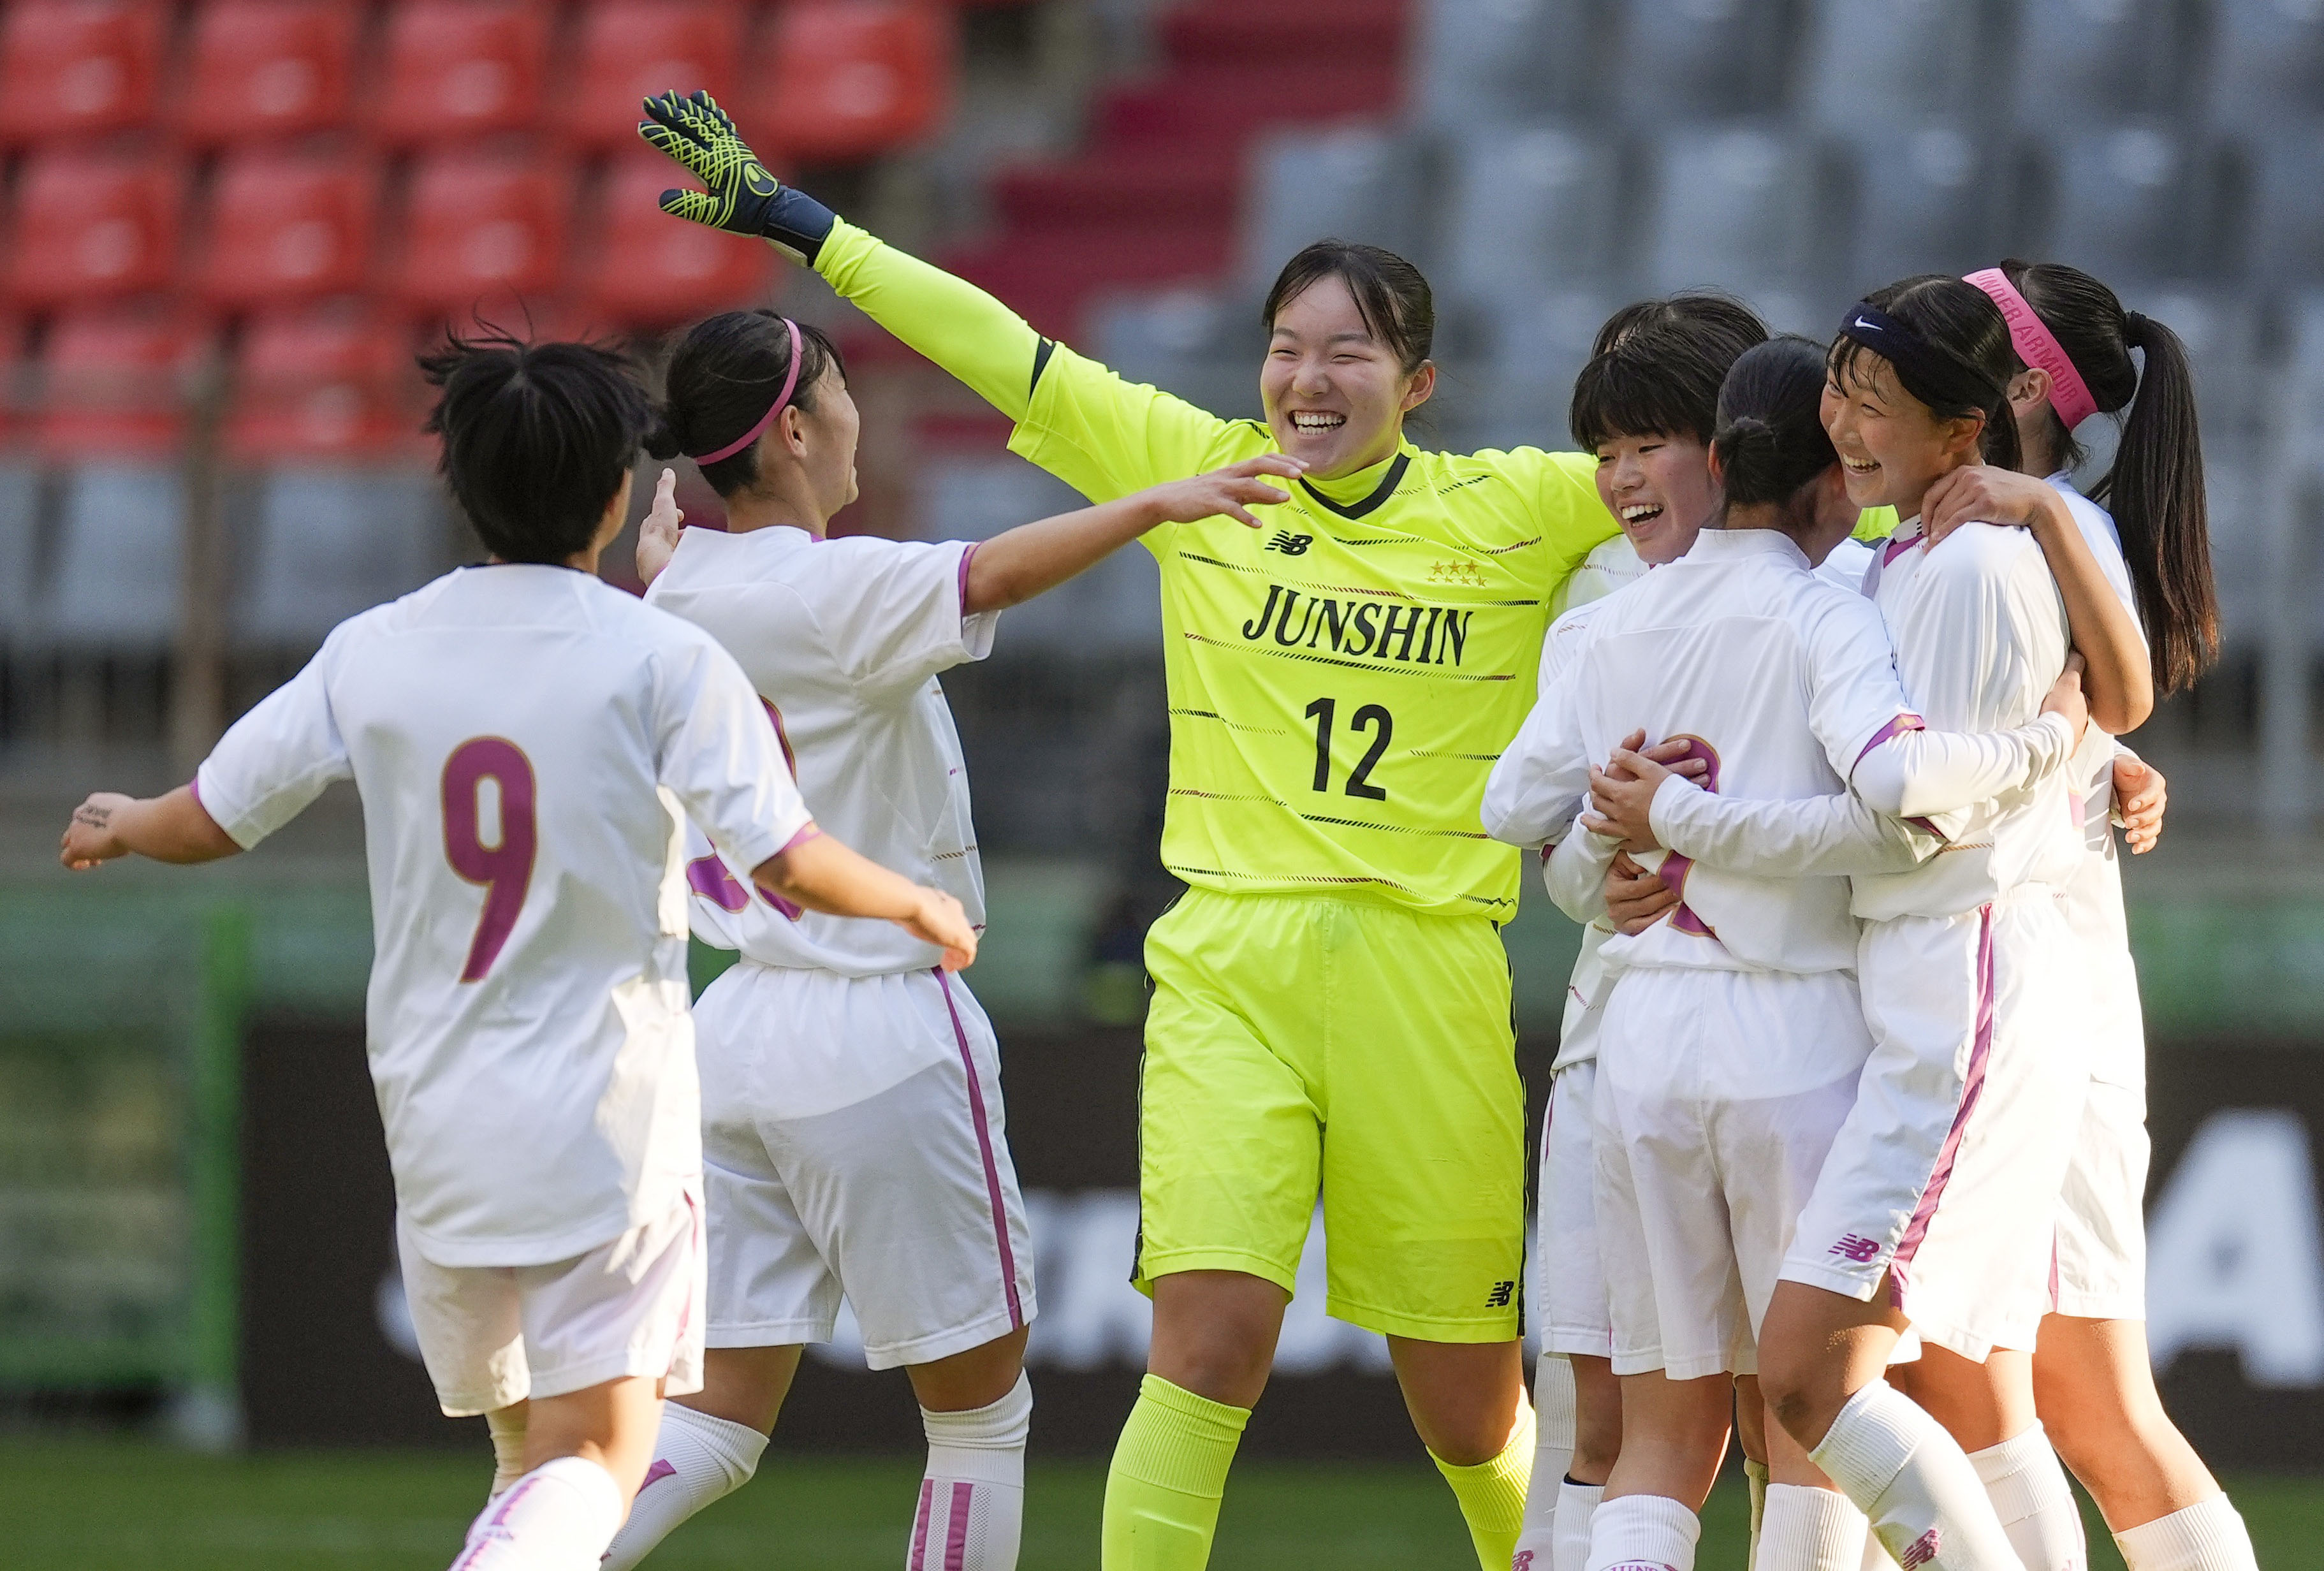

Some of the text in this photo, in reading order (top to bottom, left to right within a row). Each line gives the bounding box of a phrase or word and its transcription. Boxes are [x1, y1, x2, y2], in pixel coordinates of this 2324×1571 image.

[1977, 272, 2079, 404] UNDER ARMOUR
[1242, 585, 1474, 667] JUNSHIN
[1305, 697, 1393, 801] 12
[441, 735, 537, 984] 9
